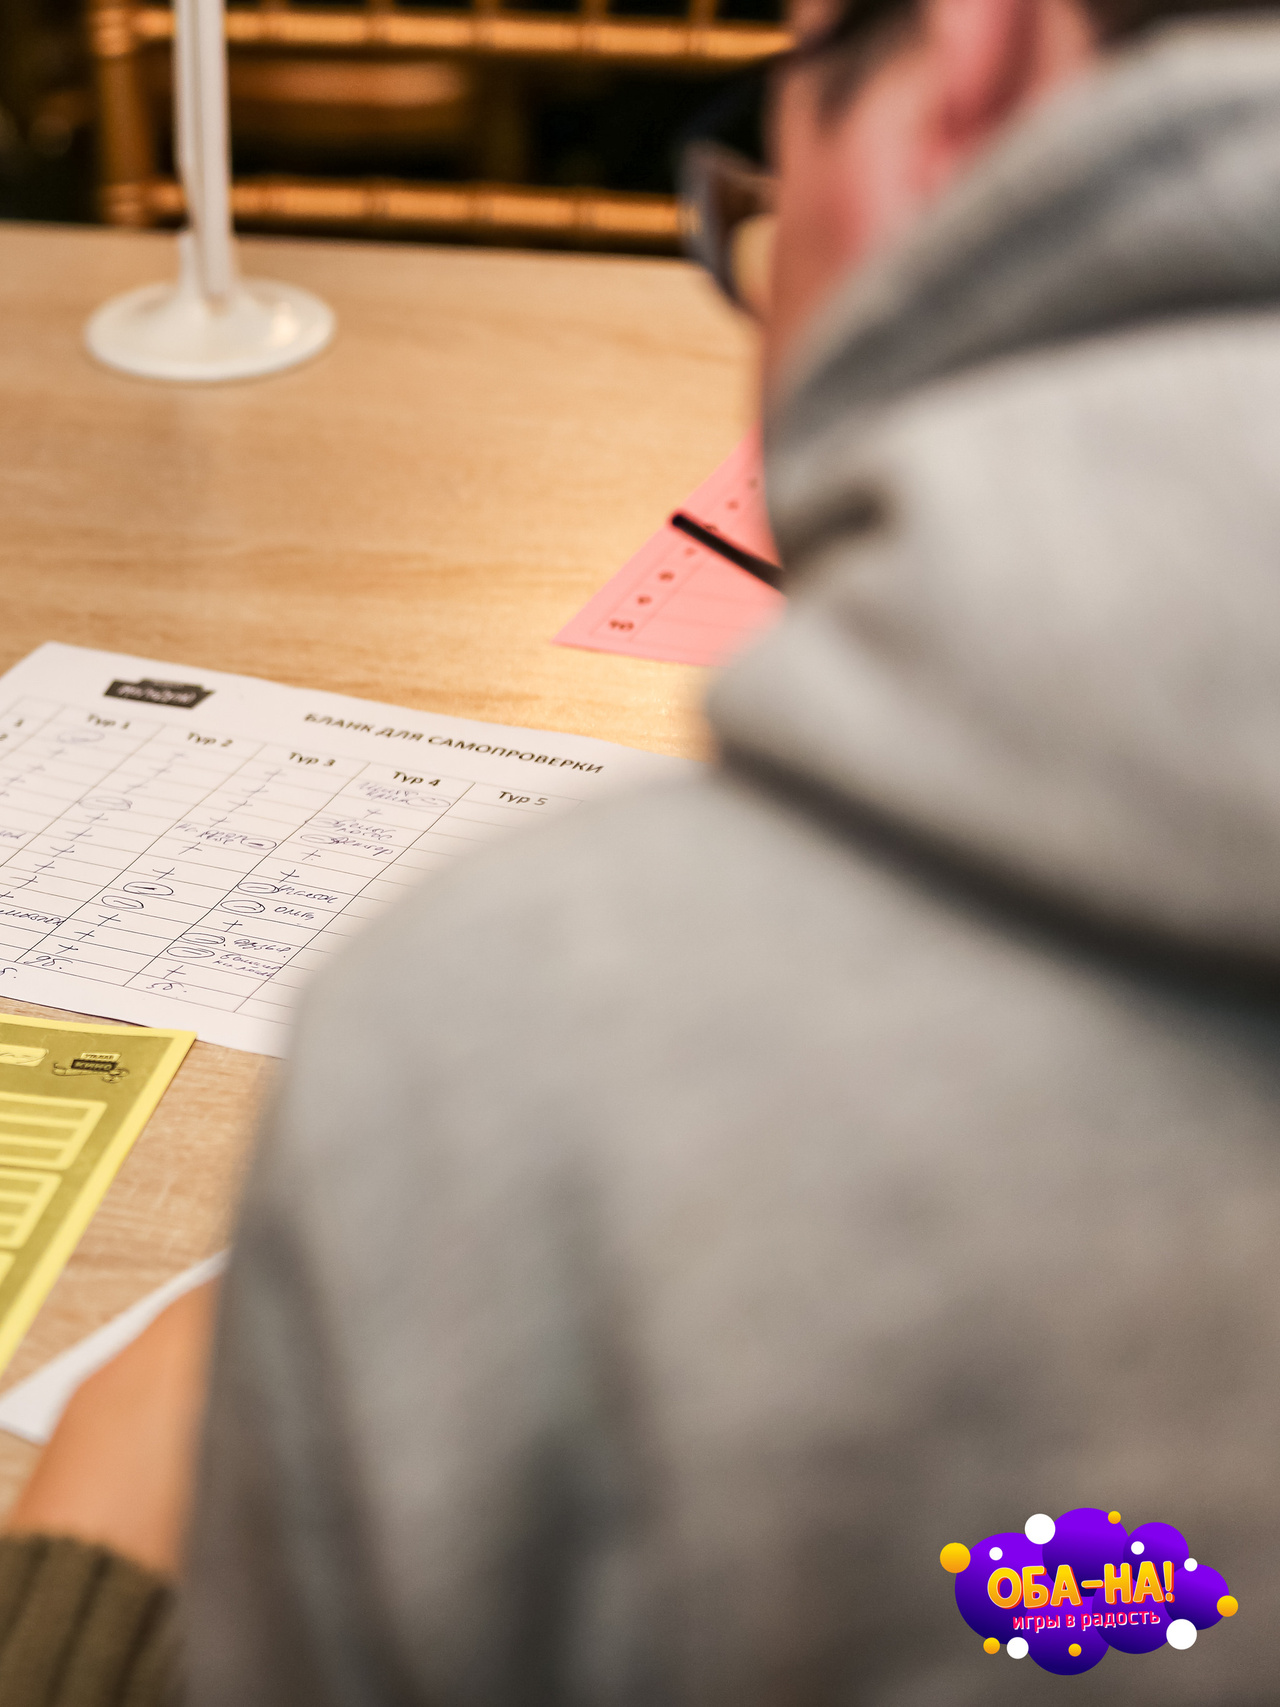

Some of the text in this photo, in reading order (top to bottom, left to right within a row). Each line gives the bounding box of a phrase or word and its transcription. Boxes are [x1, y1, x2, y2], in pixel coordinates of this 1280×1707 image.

[187, 731, 234, 748] Тур 2
[303, 712, 606, 775] БЛАНК ДЛЯ САМОПРОВЕРКИ
[288, 751, 336, 767] Тур 3
[392, 770, 441, 787] Тур 4
[497, 790, 548, 806] Тур 5
